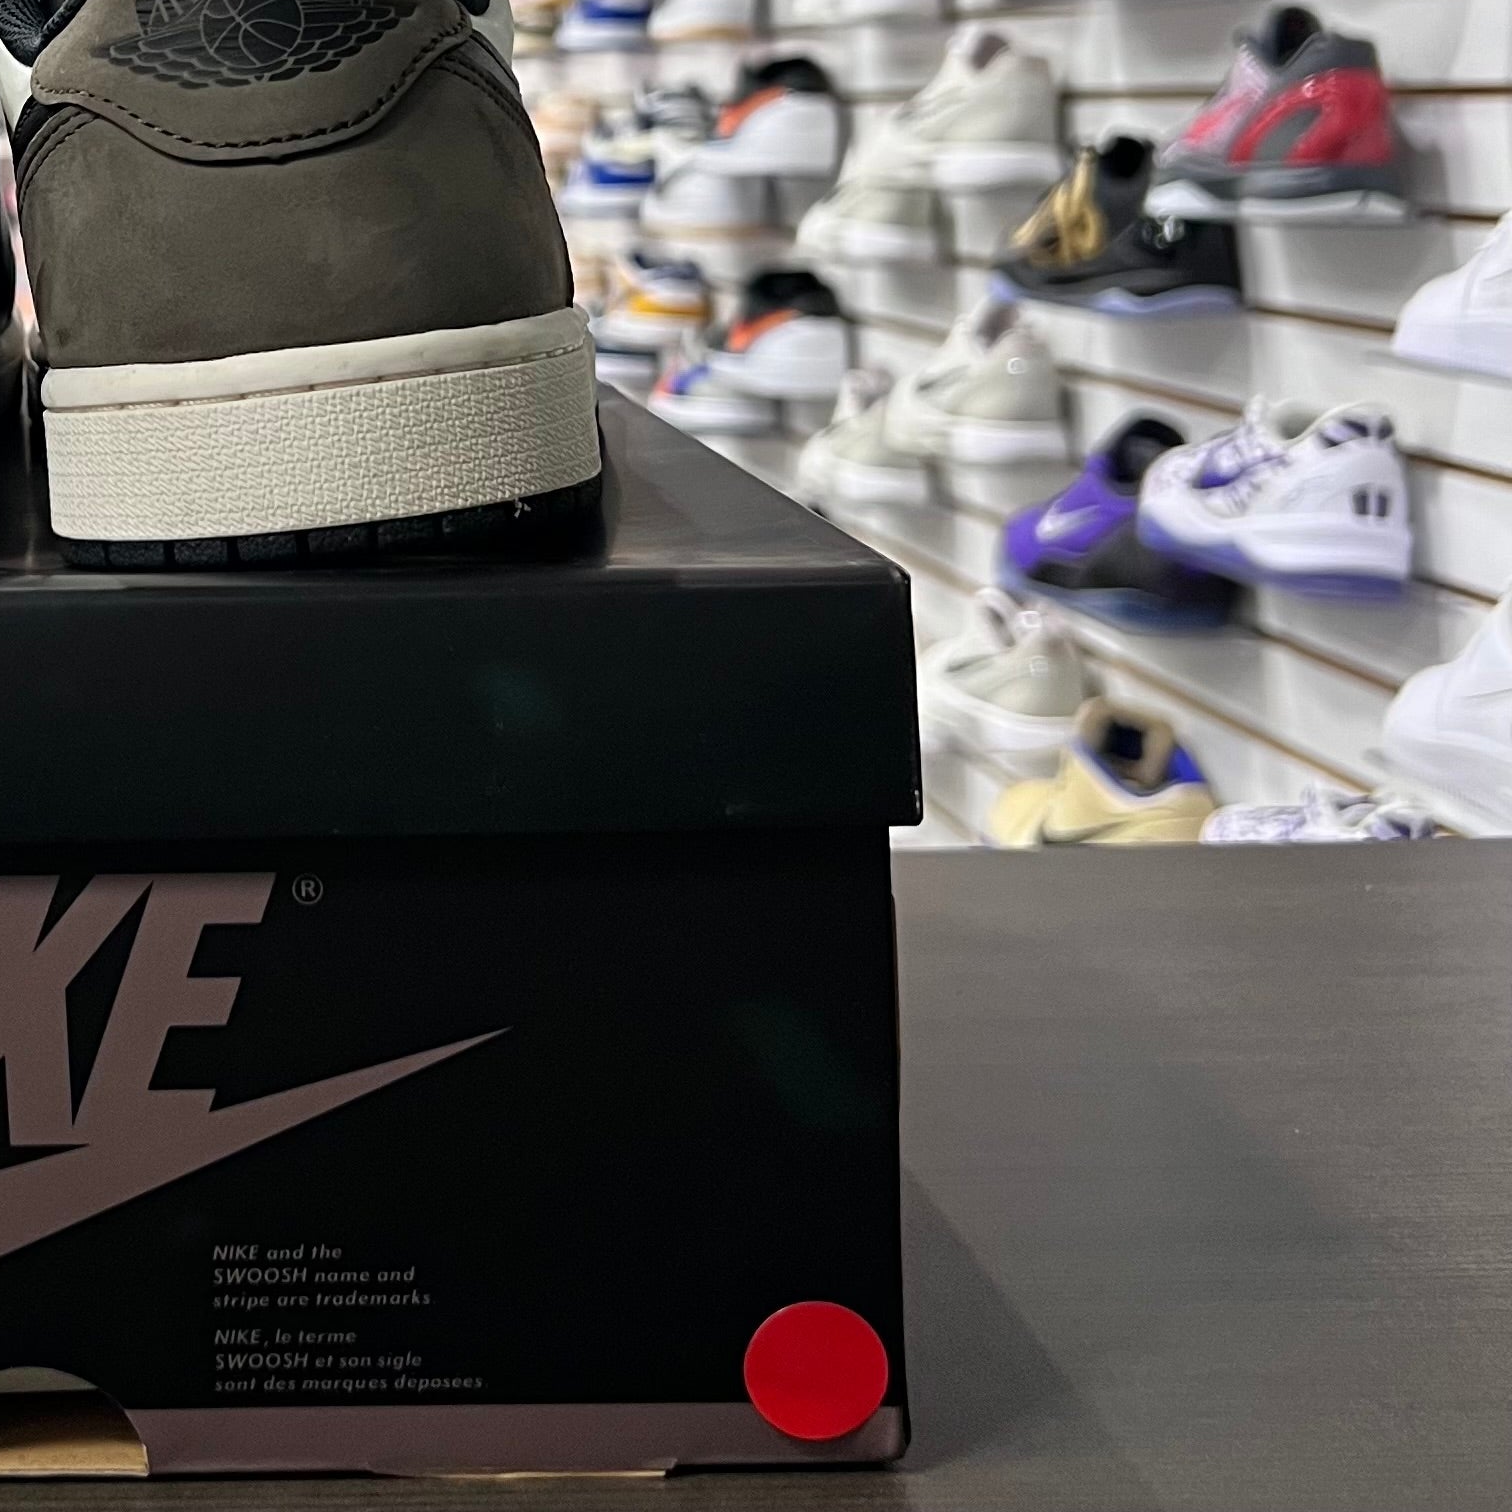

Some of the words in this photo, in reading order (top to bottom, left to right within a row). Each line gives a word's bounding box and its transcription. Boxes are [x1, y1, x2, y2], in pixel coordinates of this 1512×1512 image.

[213, 1245, 258, 1260] NIKE
[267, 1244, 304, 1260] and
[312, 1244, 341, 1259] the
[214, 1268, 306, 1284] SWOOSH
[315, 1272, 369, 1282] name
[378, 1266, 414, 1281] and
[214, 1295, 269, 1310] stripe
[278, 1296, 308, 1306] are
[215, 1329, 267, 1346] NIKE,
[276, 1329, 291, 1344] le
[299, 1331, 356, 1343] terme
[216, 1353, 308, 1369] SWOOSH
[316, 1356, 333, 1367] et
[340, 1357, 371, 1367] son
[378, 1352, 421, 1370] sigle
[216, 1378, 255, 1391] sont
[264, 1376, 295, 1390] des
[303, 1379, 387, 1392] marques
